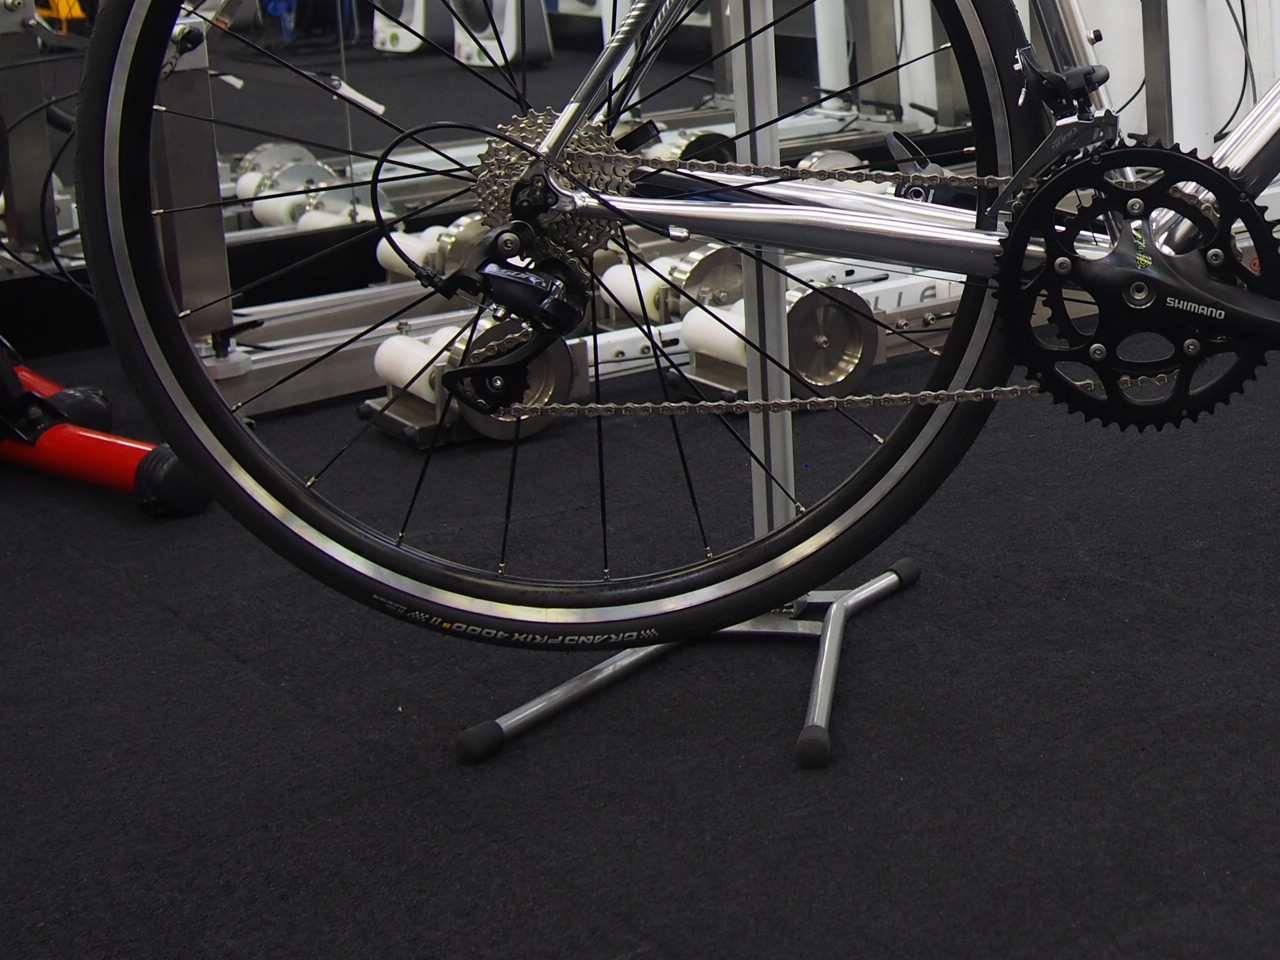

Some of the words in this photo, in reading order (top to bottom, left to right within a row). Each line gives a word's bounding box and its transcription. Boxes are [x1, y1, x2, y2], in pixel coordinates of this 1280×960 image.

[1165, 296, 1226, 320] SHIMANO
[452, 622, 509, 638] 4000
[511, 632, 564, 644] PRIX
[565, 631, 638, 644] GRAND
